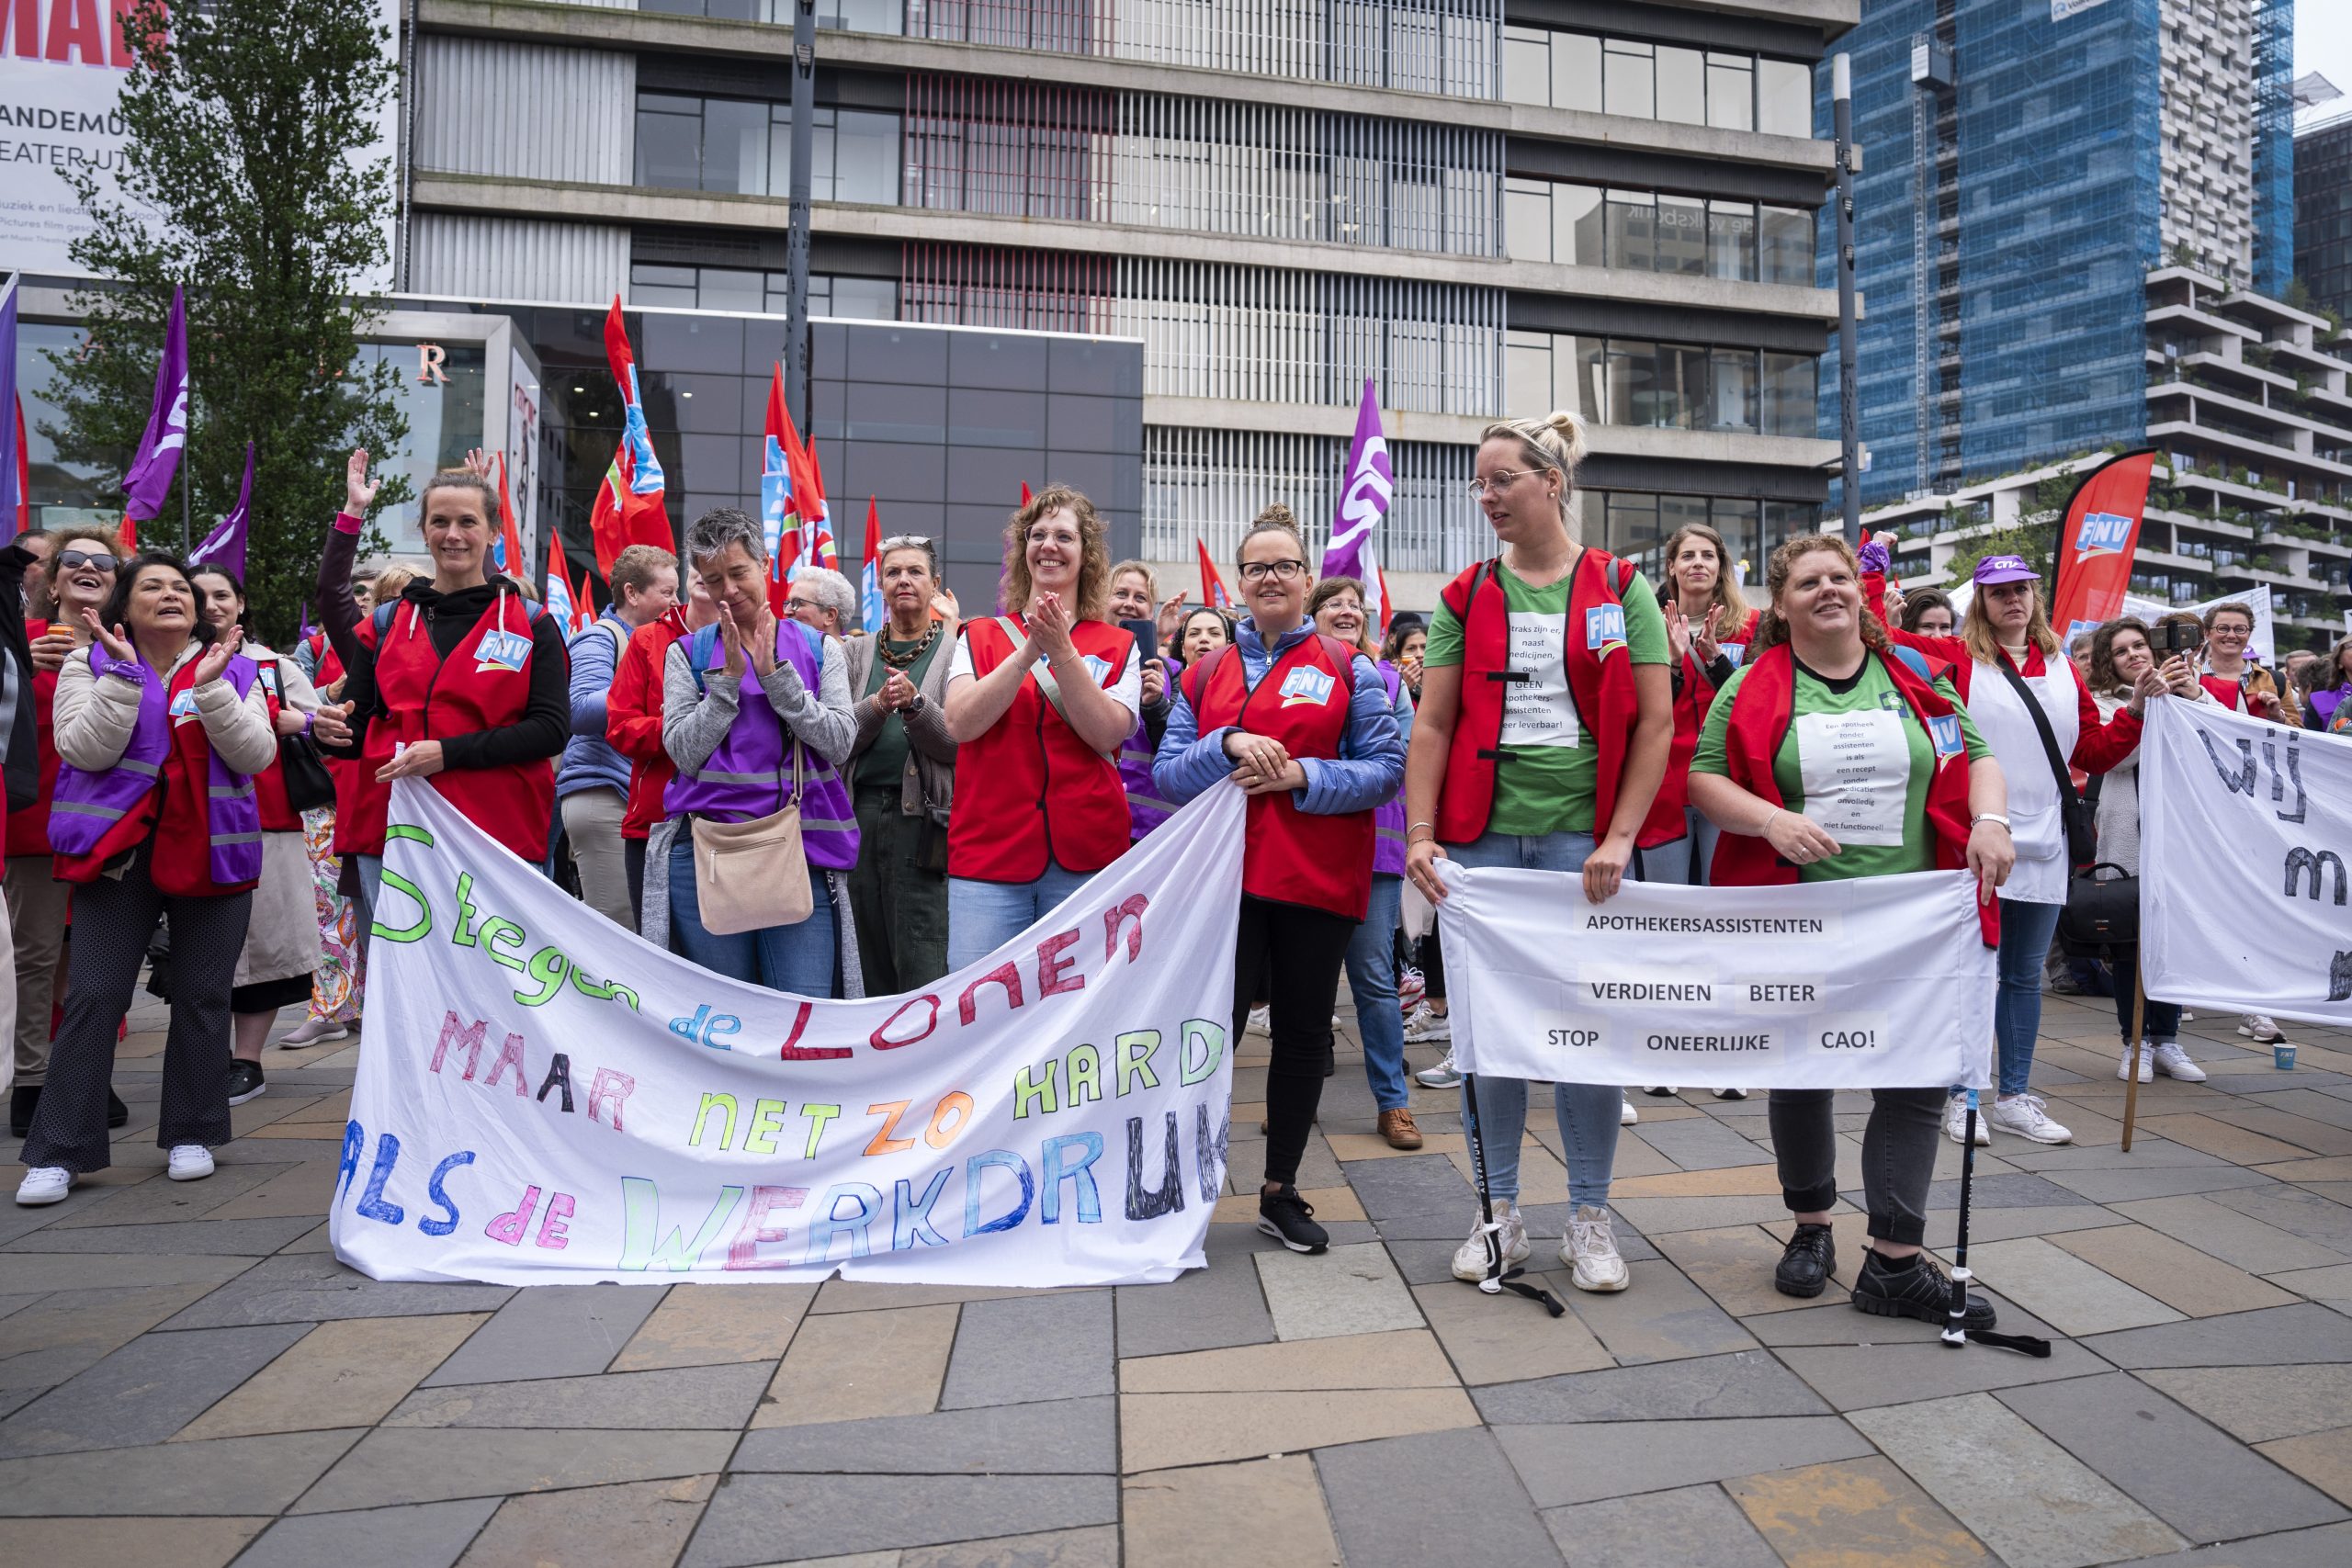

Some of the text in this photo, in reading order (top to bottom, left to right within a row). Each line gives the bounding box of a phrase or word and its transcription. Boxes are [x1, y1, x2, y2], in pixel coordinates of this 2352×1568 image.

[39, 204, 55, 213] en
[2076, 520, 2131, 546] FNV
[1534, 626, 1547, 634] zijn
[1589, 613, 1627, 640] FN
[480, 637, 531, 660] FNV
[1522, 665, 1539, 673] ook
[1284, 672, 1332, 695] FNV
[1515, 680, 1544, 689] GEEN
[1506, 694, 1554, 703] pothekers-
[1505, 706, 1552, 715] assistenten
[1519, 720, 1563, 728] leverbaar!
[1841, 720, 1875, 728] apotheek
[1837, 765, 1876, 774] een recept
[1838, 797, 1875, 807] onvolledig
[1586, 915, 1824, 934] APOTHEKERSASSISTENTEN
[1591, 982, 1815, 1002] VERDIENEN BETER
[669, 1004, 741, 1051] de
[1548, 1029, 1875, 1052] STOP ONEERLIJKE CAO!
[429, 1010, 635, 1134] MAAR
[1012, 1018, 1226, 1121] HARD
